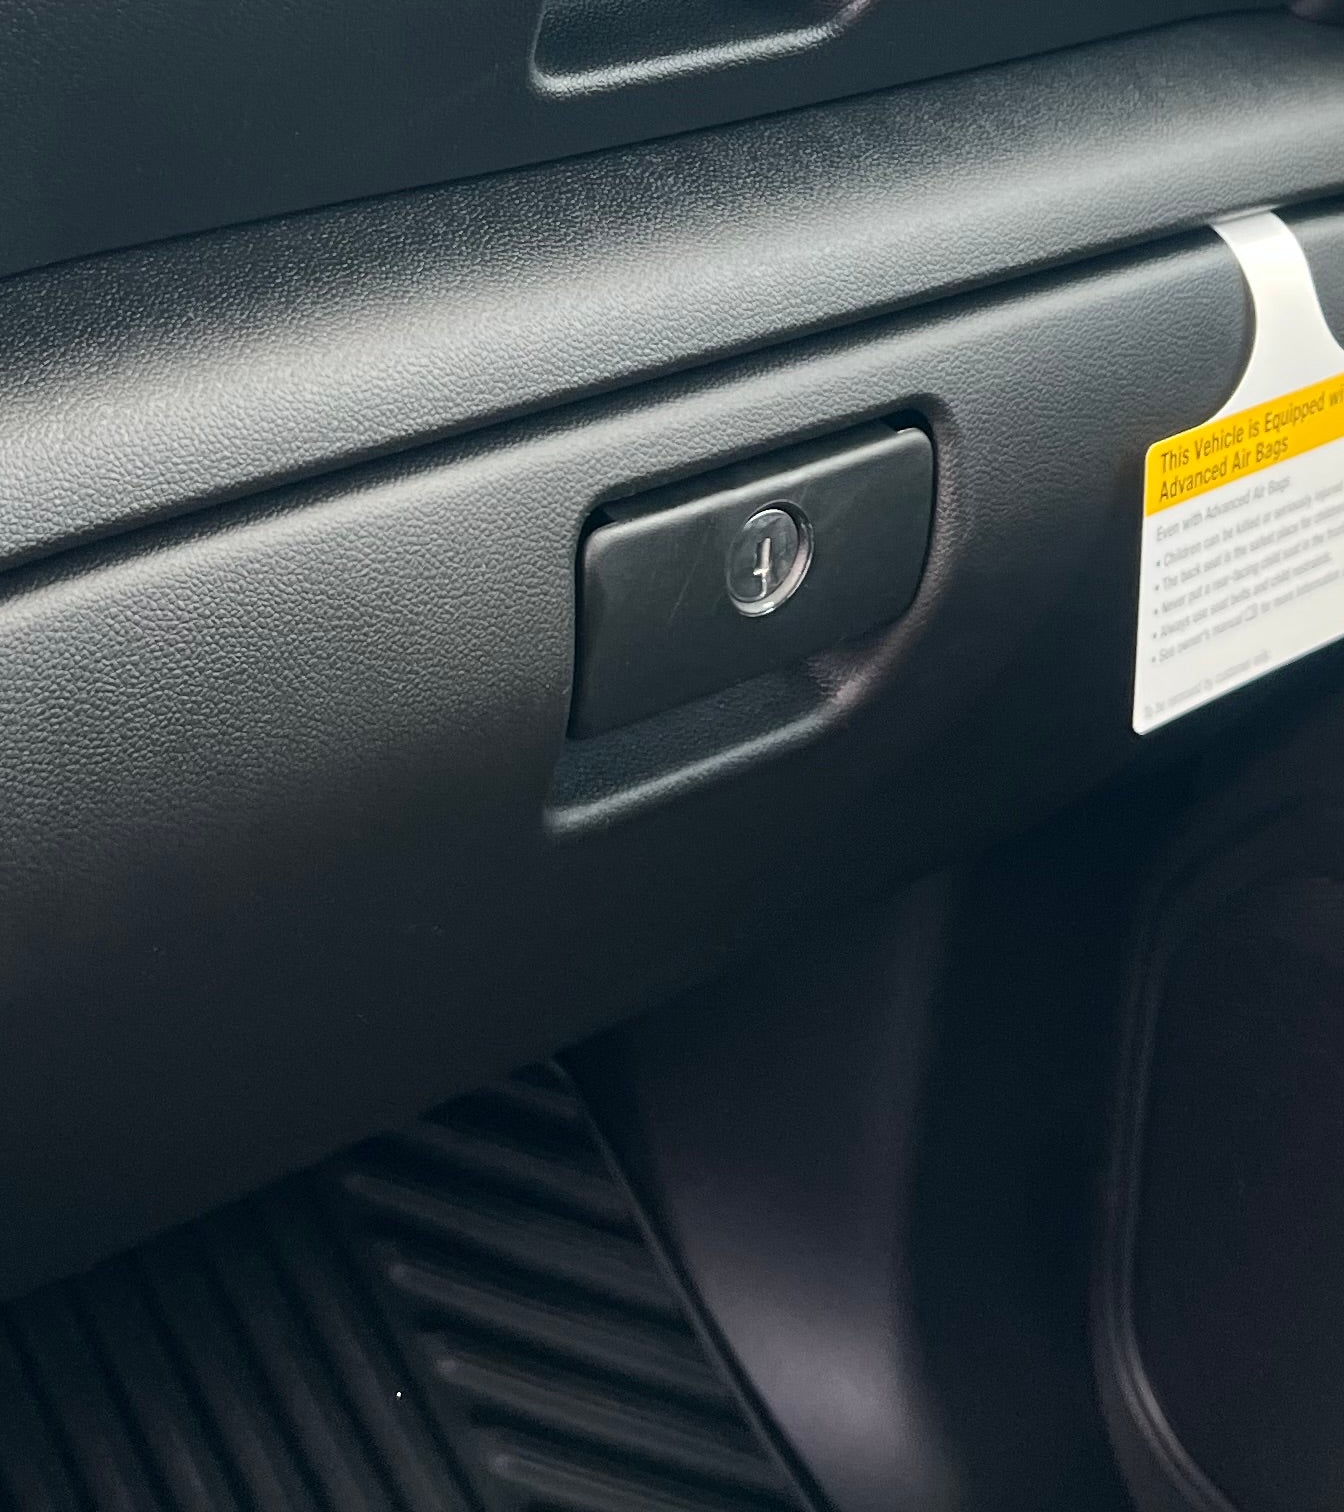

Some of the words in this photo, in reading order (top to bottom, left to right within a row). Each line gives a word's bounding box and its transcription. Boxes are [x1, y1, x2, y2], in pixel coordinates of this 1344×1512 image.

[1161, 446, 1189, 473] This
[1194, 424, 1244, 460] Vehicle
[1249, 418, 1260, 438] is
[1264, 393, 1325, 431] Equipped
[1159, 455, 1228, 502] Advanced
[1231, 448, 1251, 473] Air
[1256, 436, 1288, 464] Bags
[1205, 490, 1249, 519] Advanced
